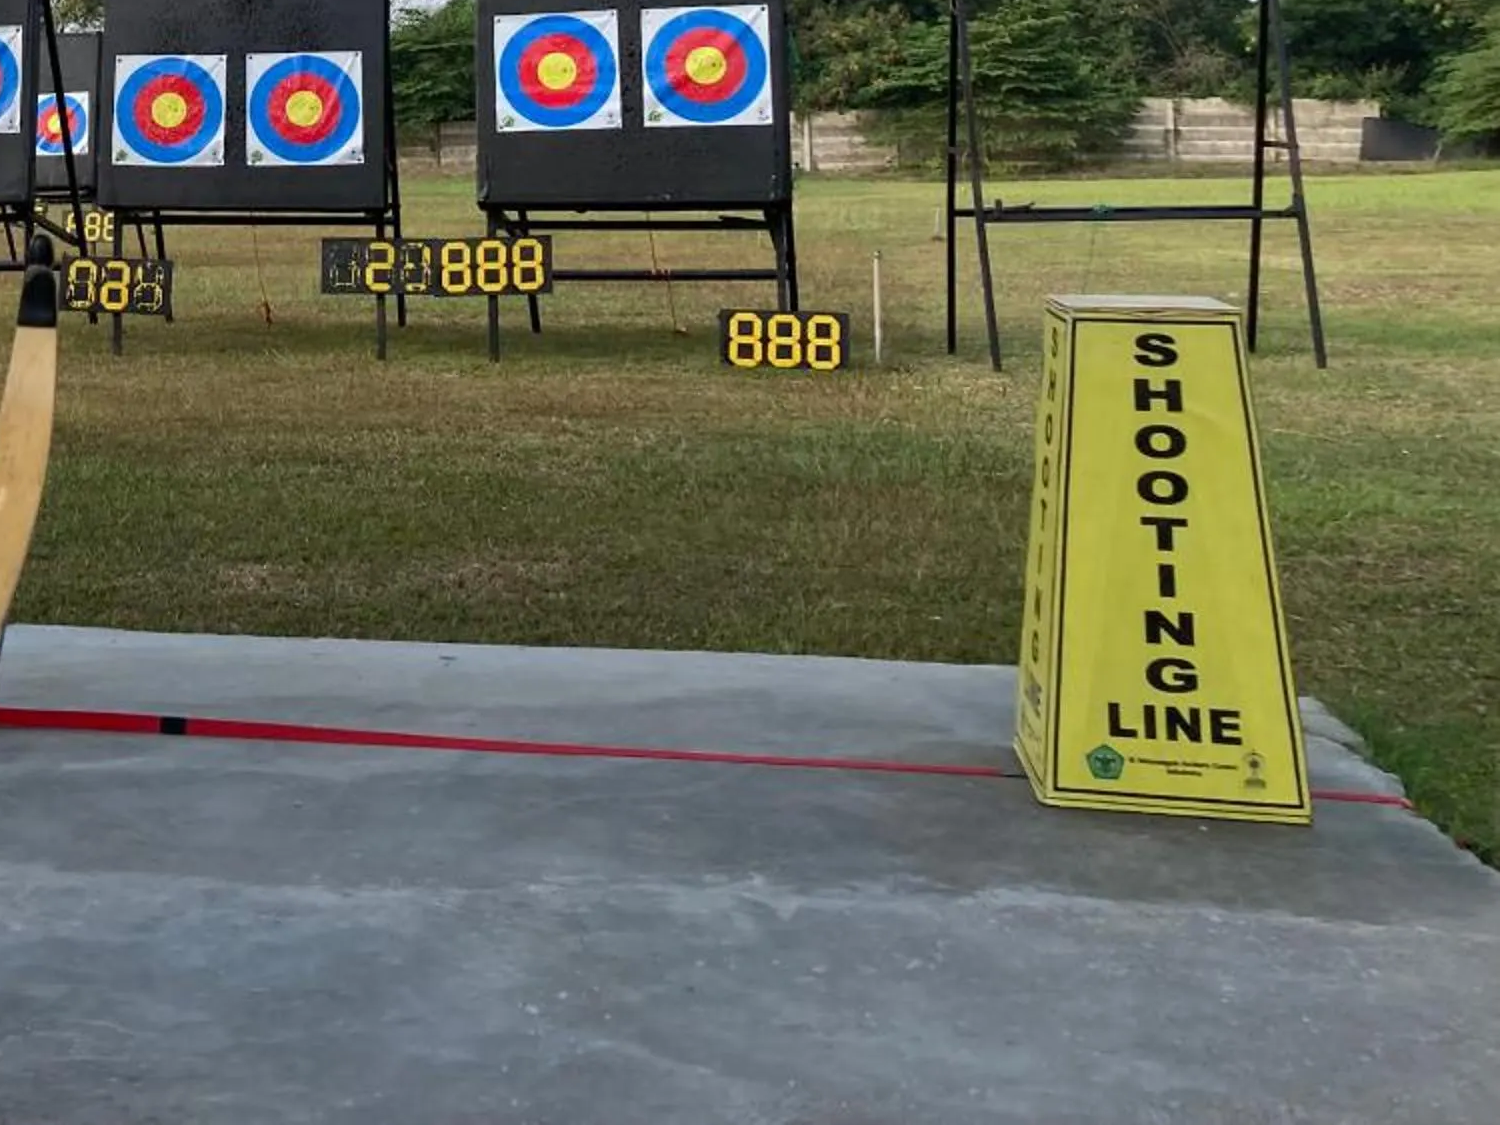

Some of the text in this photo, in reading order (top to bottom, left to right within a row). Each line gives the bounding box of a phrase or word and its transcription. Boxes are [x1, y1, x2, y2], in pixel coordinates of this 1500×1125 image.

[441, 238, 544, 293] 888
[729, 312, 841, 370] 888
[1133, 332, 1198, 694] SHOOTING
[1107, 702, 1242, 746] LINE
